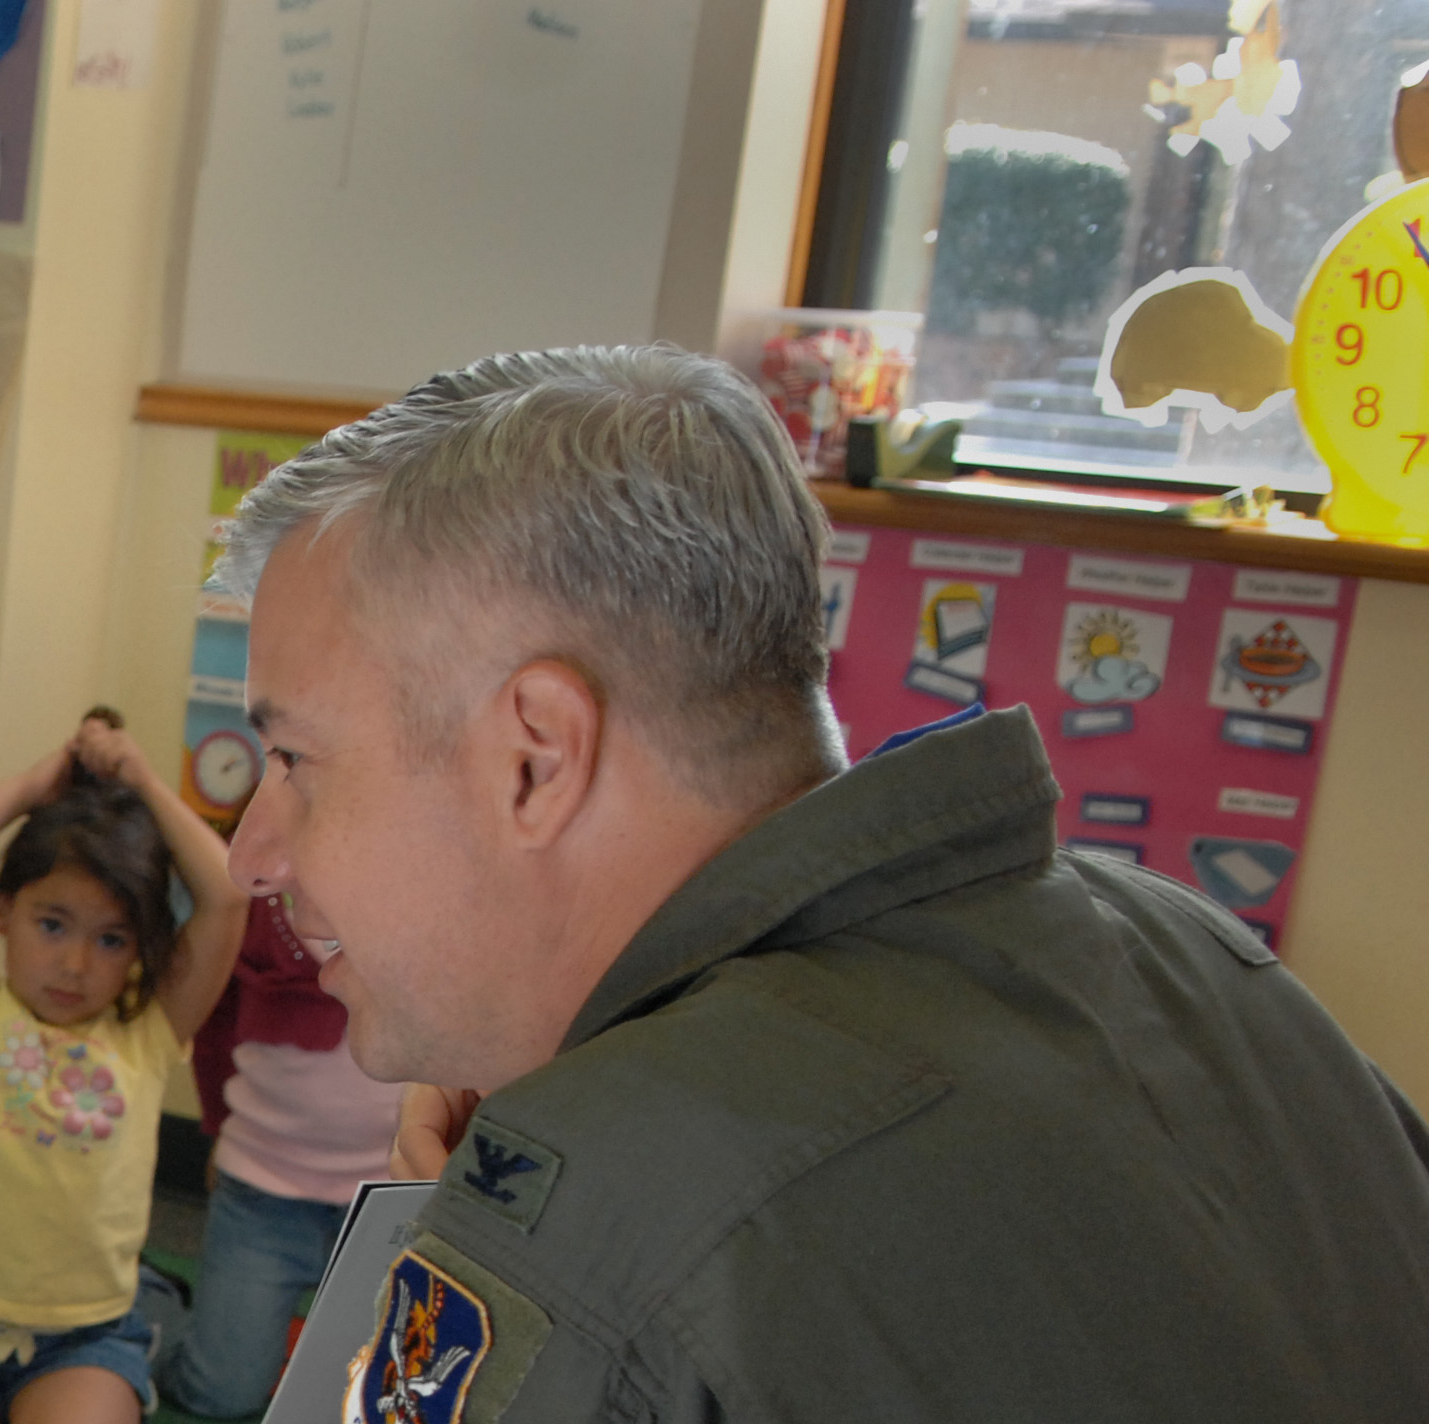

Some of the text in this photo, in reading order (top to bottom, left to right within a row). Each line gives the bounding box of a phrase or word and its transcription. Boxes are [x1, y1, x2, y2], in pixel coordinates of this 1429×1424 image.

[1350, 266, 1404, 312] 10
[1335, 322, 1365, 367] 9
[1352, 386, 1381, 429] 8
[1400, 433, 1428, 475] 7
